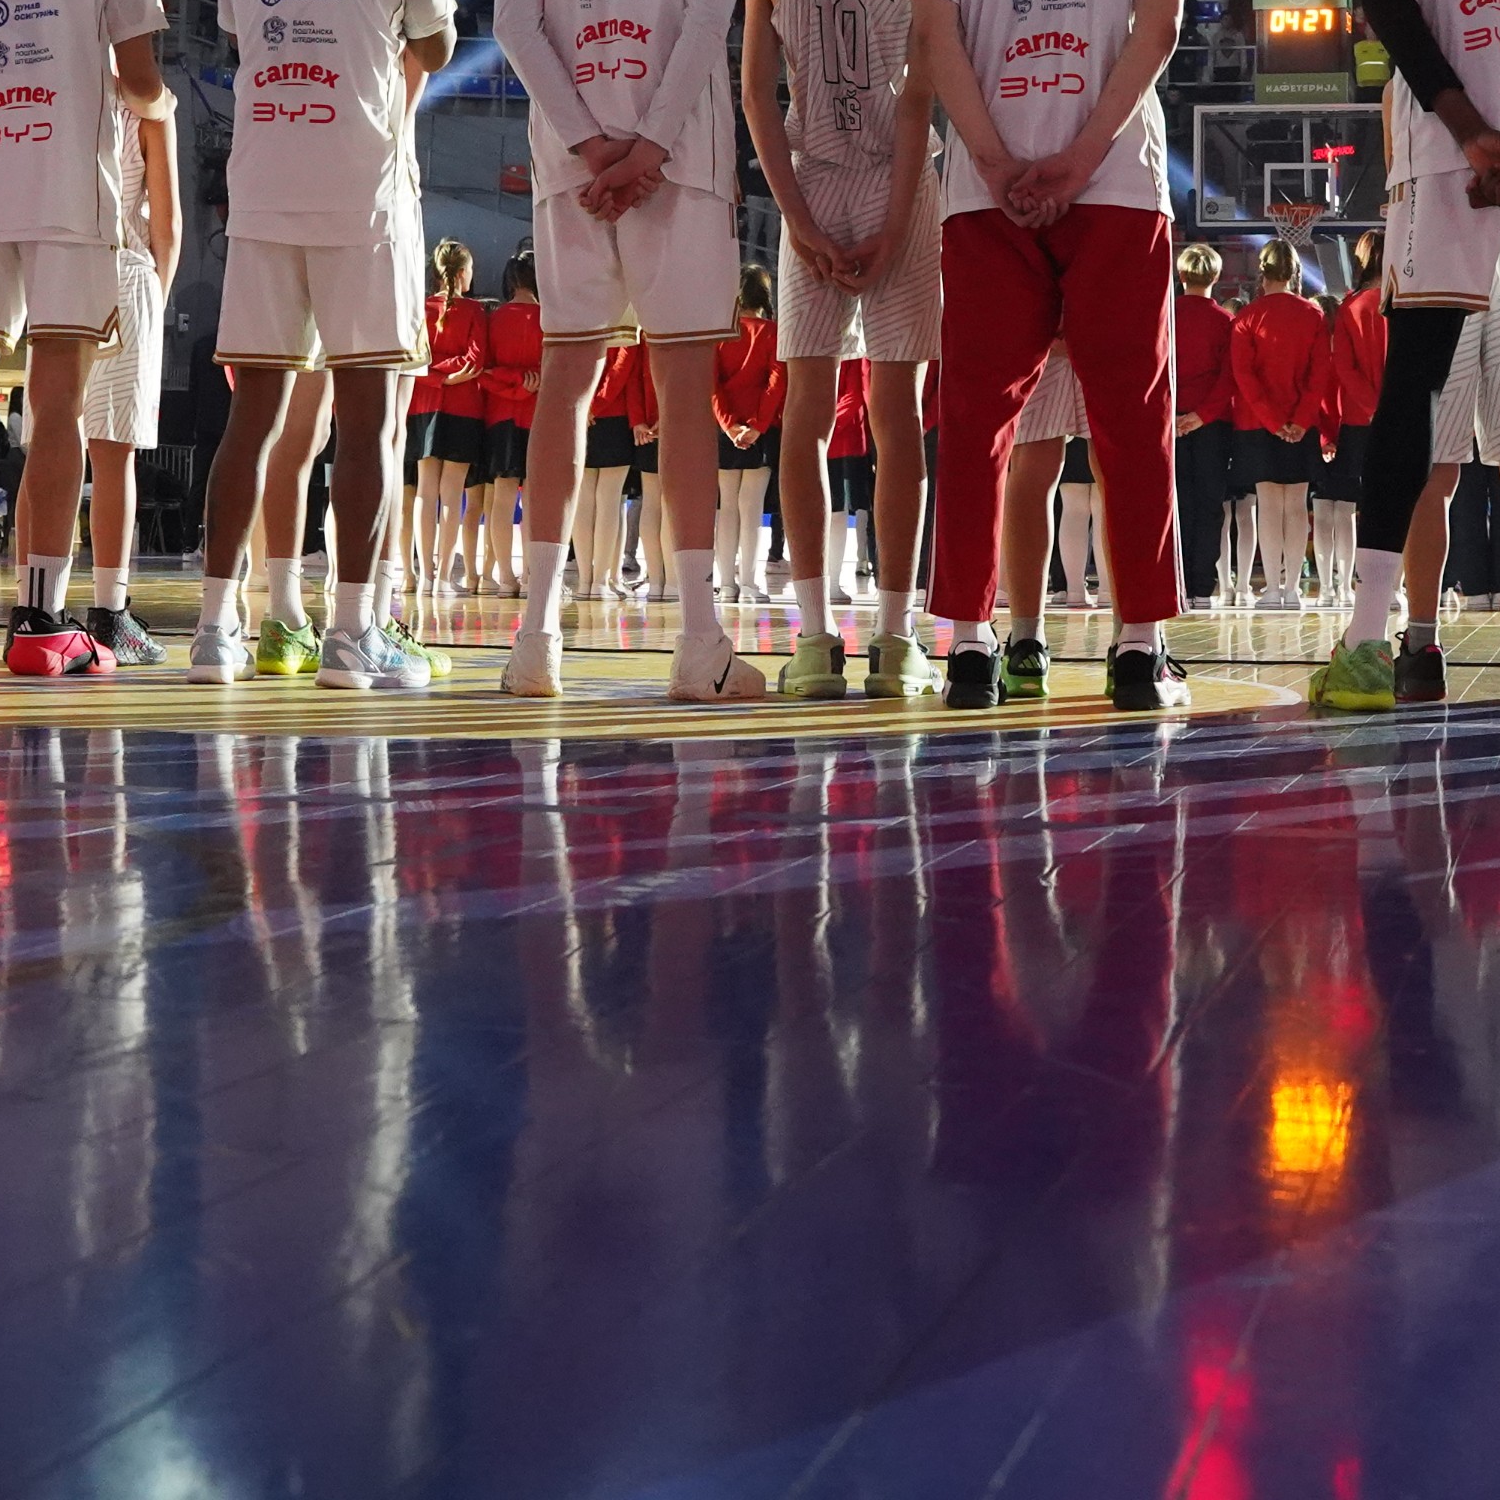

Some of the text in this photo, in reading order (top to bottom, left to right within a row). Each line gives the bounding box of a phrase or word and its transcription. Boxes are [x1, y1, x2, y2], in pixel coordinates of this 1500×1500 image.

[576, 18, 652, 50] carnex
[1005, 31, 1090, 63] carnex
[254, 63, 340, 89] carnex
